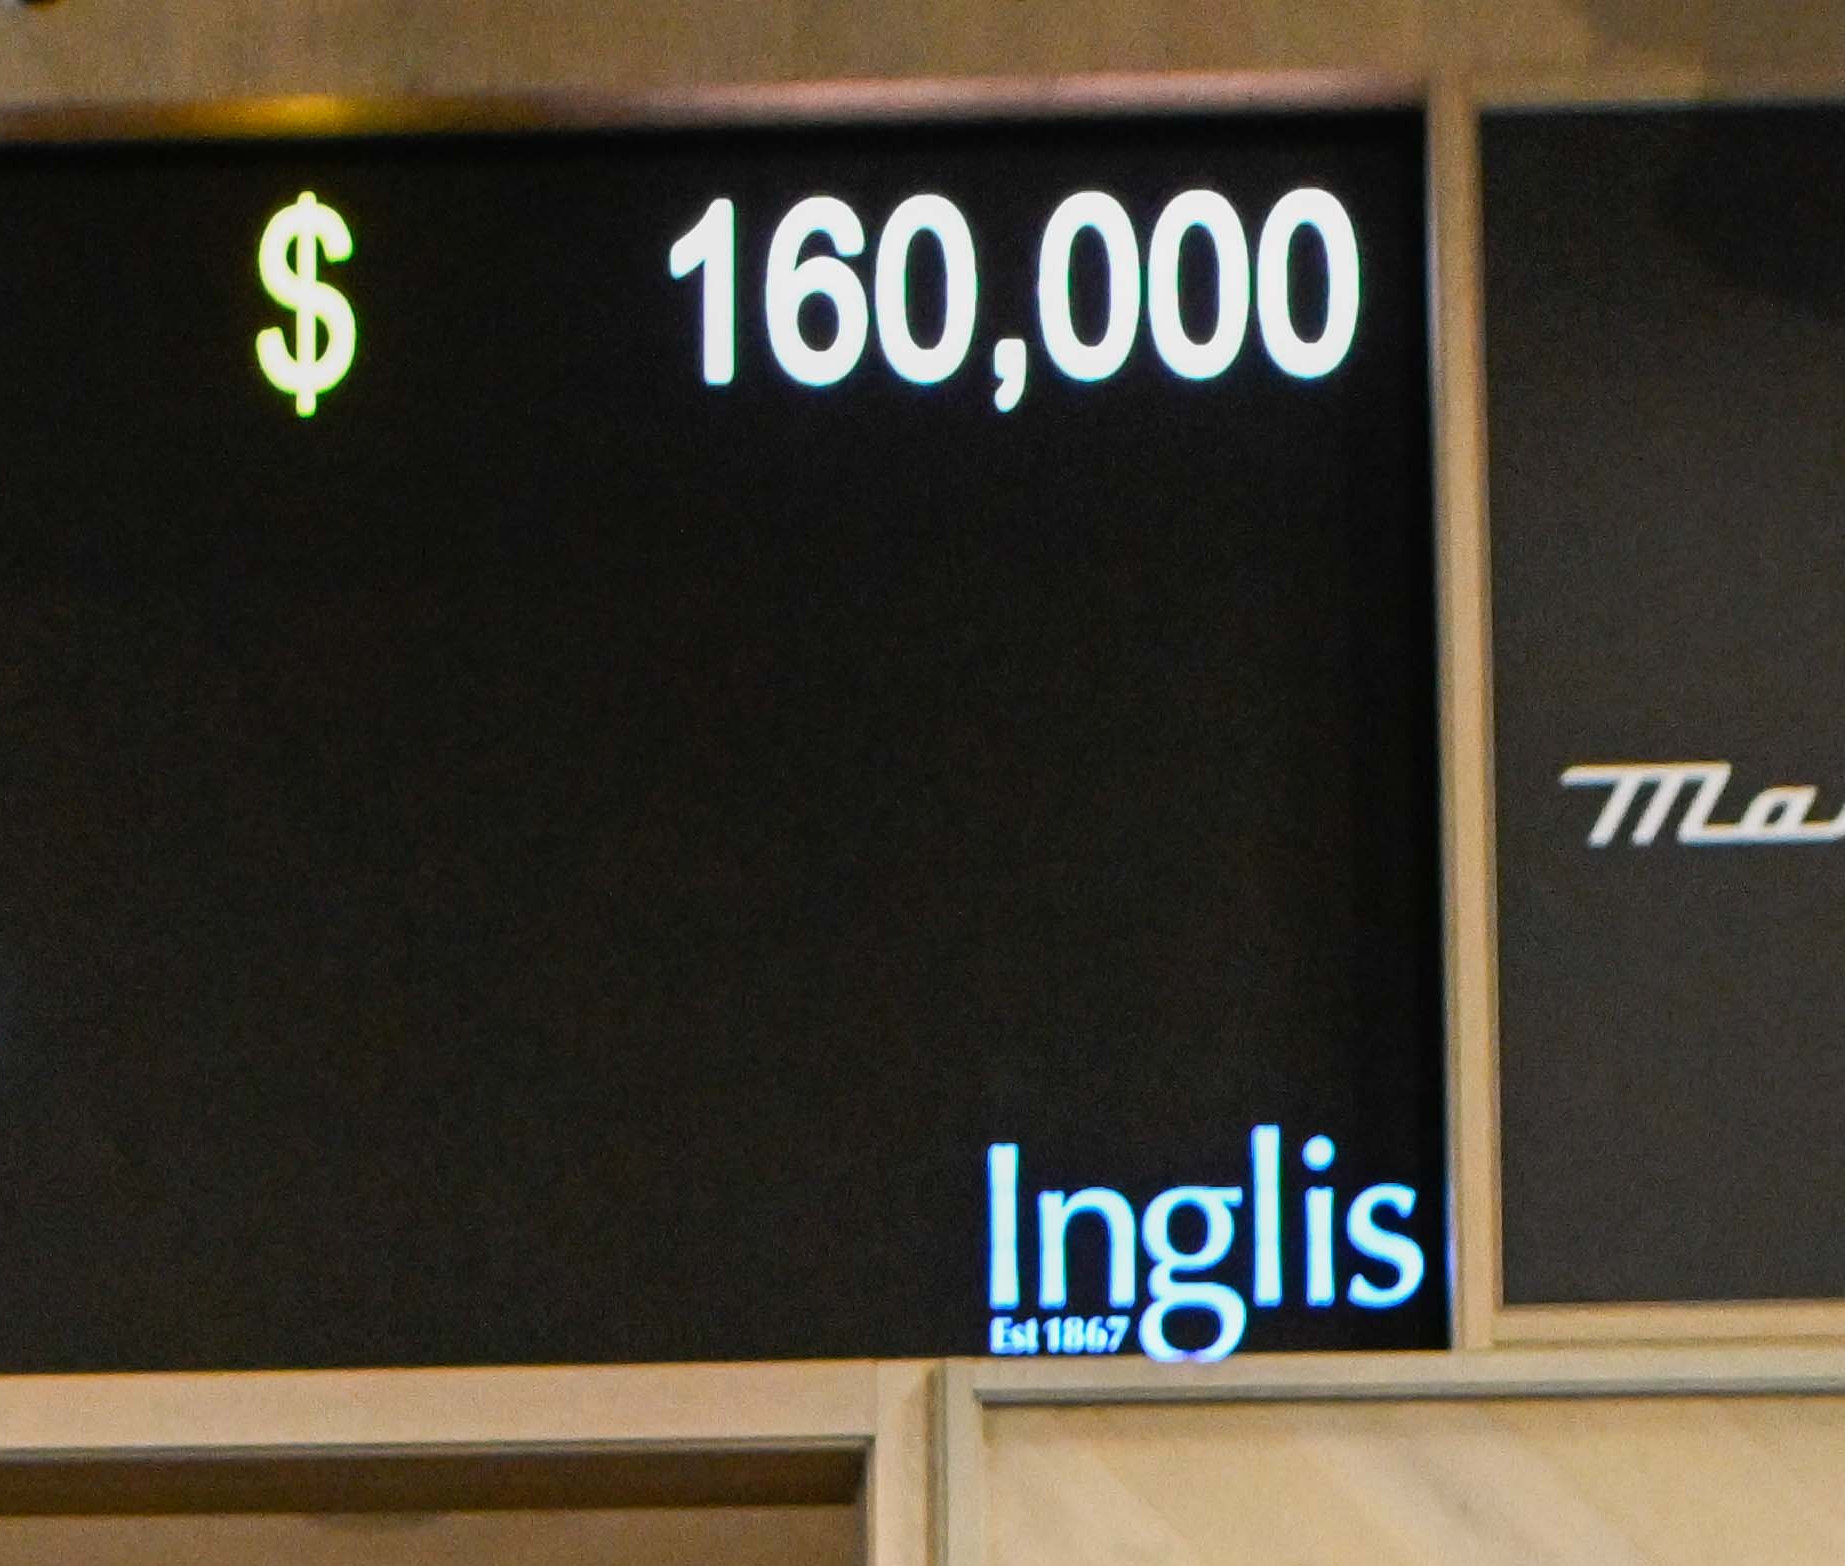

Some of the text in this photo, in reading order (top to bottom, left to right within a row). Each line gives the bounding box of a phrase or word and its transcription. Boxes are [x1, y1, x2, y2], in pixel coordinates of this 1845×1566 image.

[253, 190, 359, 420] $
[667, 184, 1363, 414] 160,000
[1559, 758, 1845, 848] Ma
[985, 1123, 1427, 1364] Inglis
[989, 1314, 1133, 1356] Est 1867
